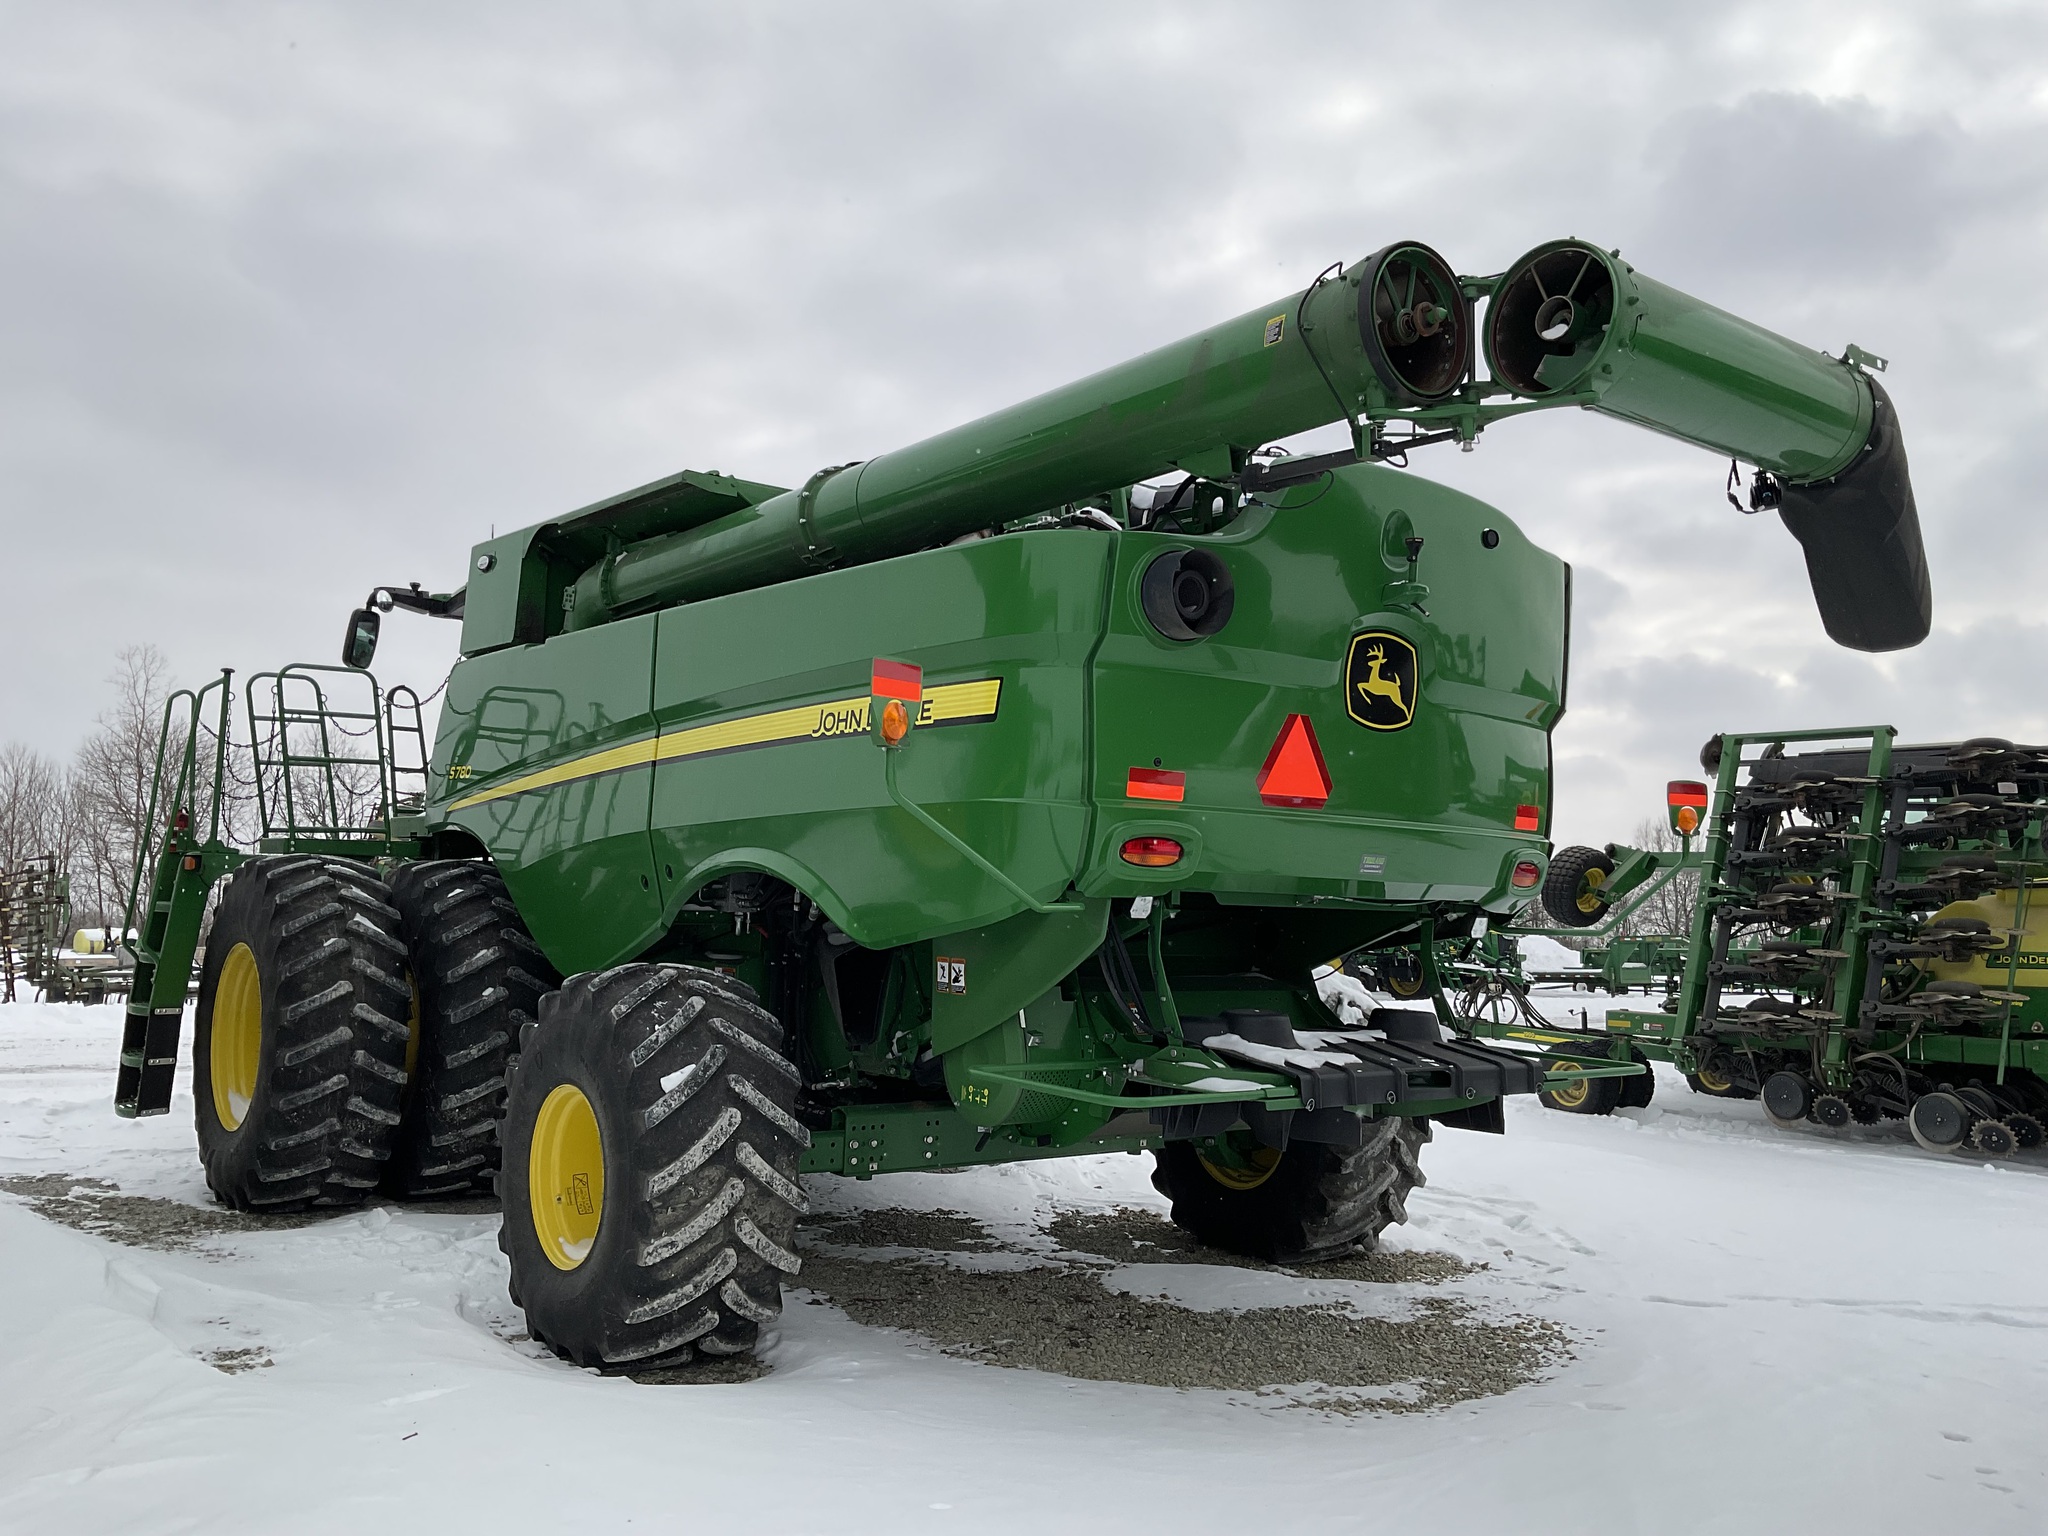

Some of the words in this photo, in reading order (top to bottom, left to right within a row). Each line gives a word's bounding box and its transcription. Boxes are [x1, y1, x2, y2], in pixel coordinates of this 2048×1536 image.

[811, 708, 863, 734] JOHN
[449, 765, 472, 779] S780
[1996, 954, 2028, 964] JON
